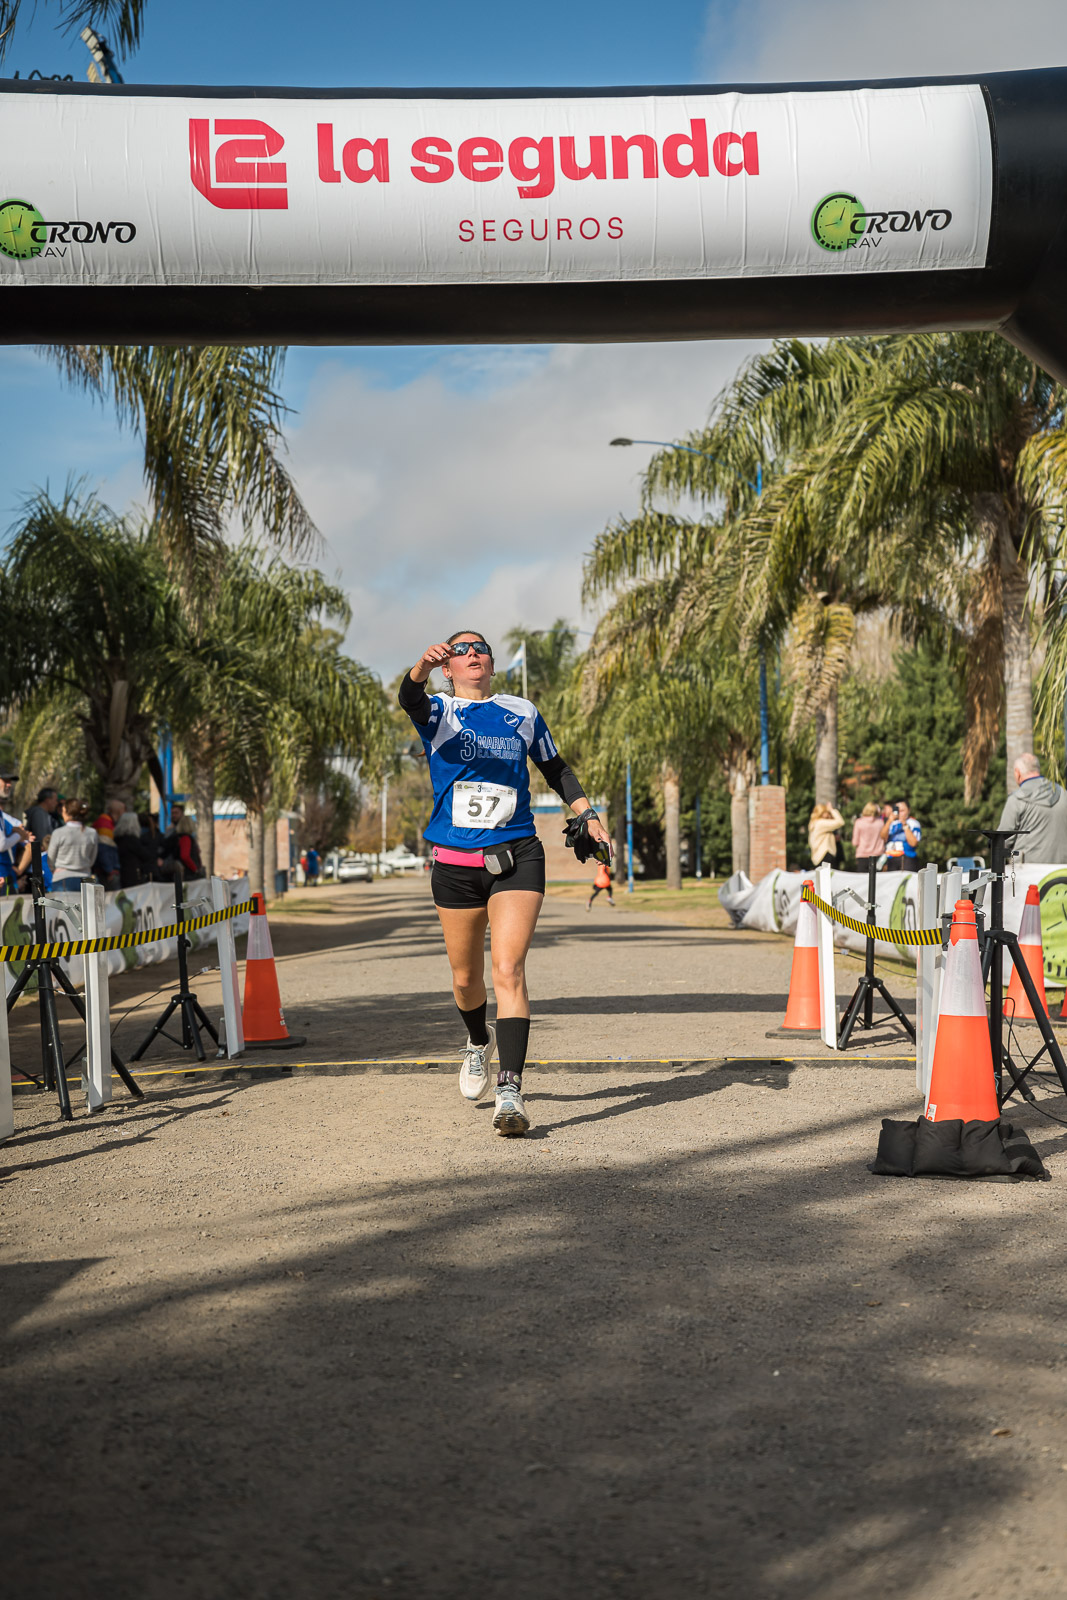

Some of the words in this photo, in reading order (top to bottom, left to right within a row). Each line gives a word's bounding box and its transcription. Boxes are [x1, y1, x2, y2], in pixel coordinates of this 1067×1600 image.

[317, 123, 390, 184] la
[411, 118, 760, 199] segunda
[458, 216, 624, 242] SEGUROS
[849, 208, 953, 233] CRONO
[31, 221, 137, 244] CRONO
[846, 236, 884, 250] RAV
[30, 246, 68, 258] RAV
[460, 728, 476, 761] 3
[477, 735, 522, 752] MARATÓN
[467, 795, 501, 818] 57
